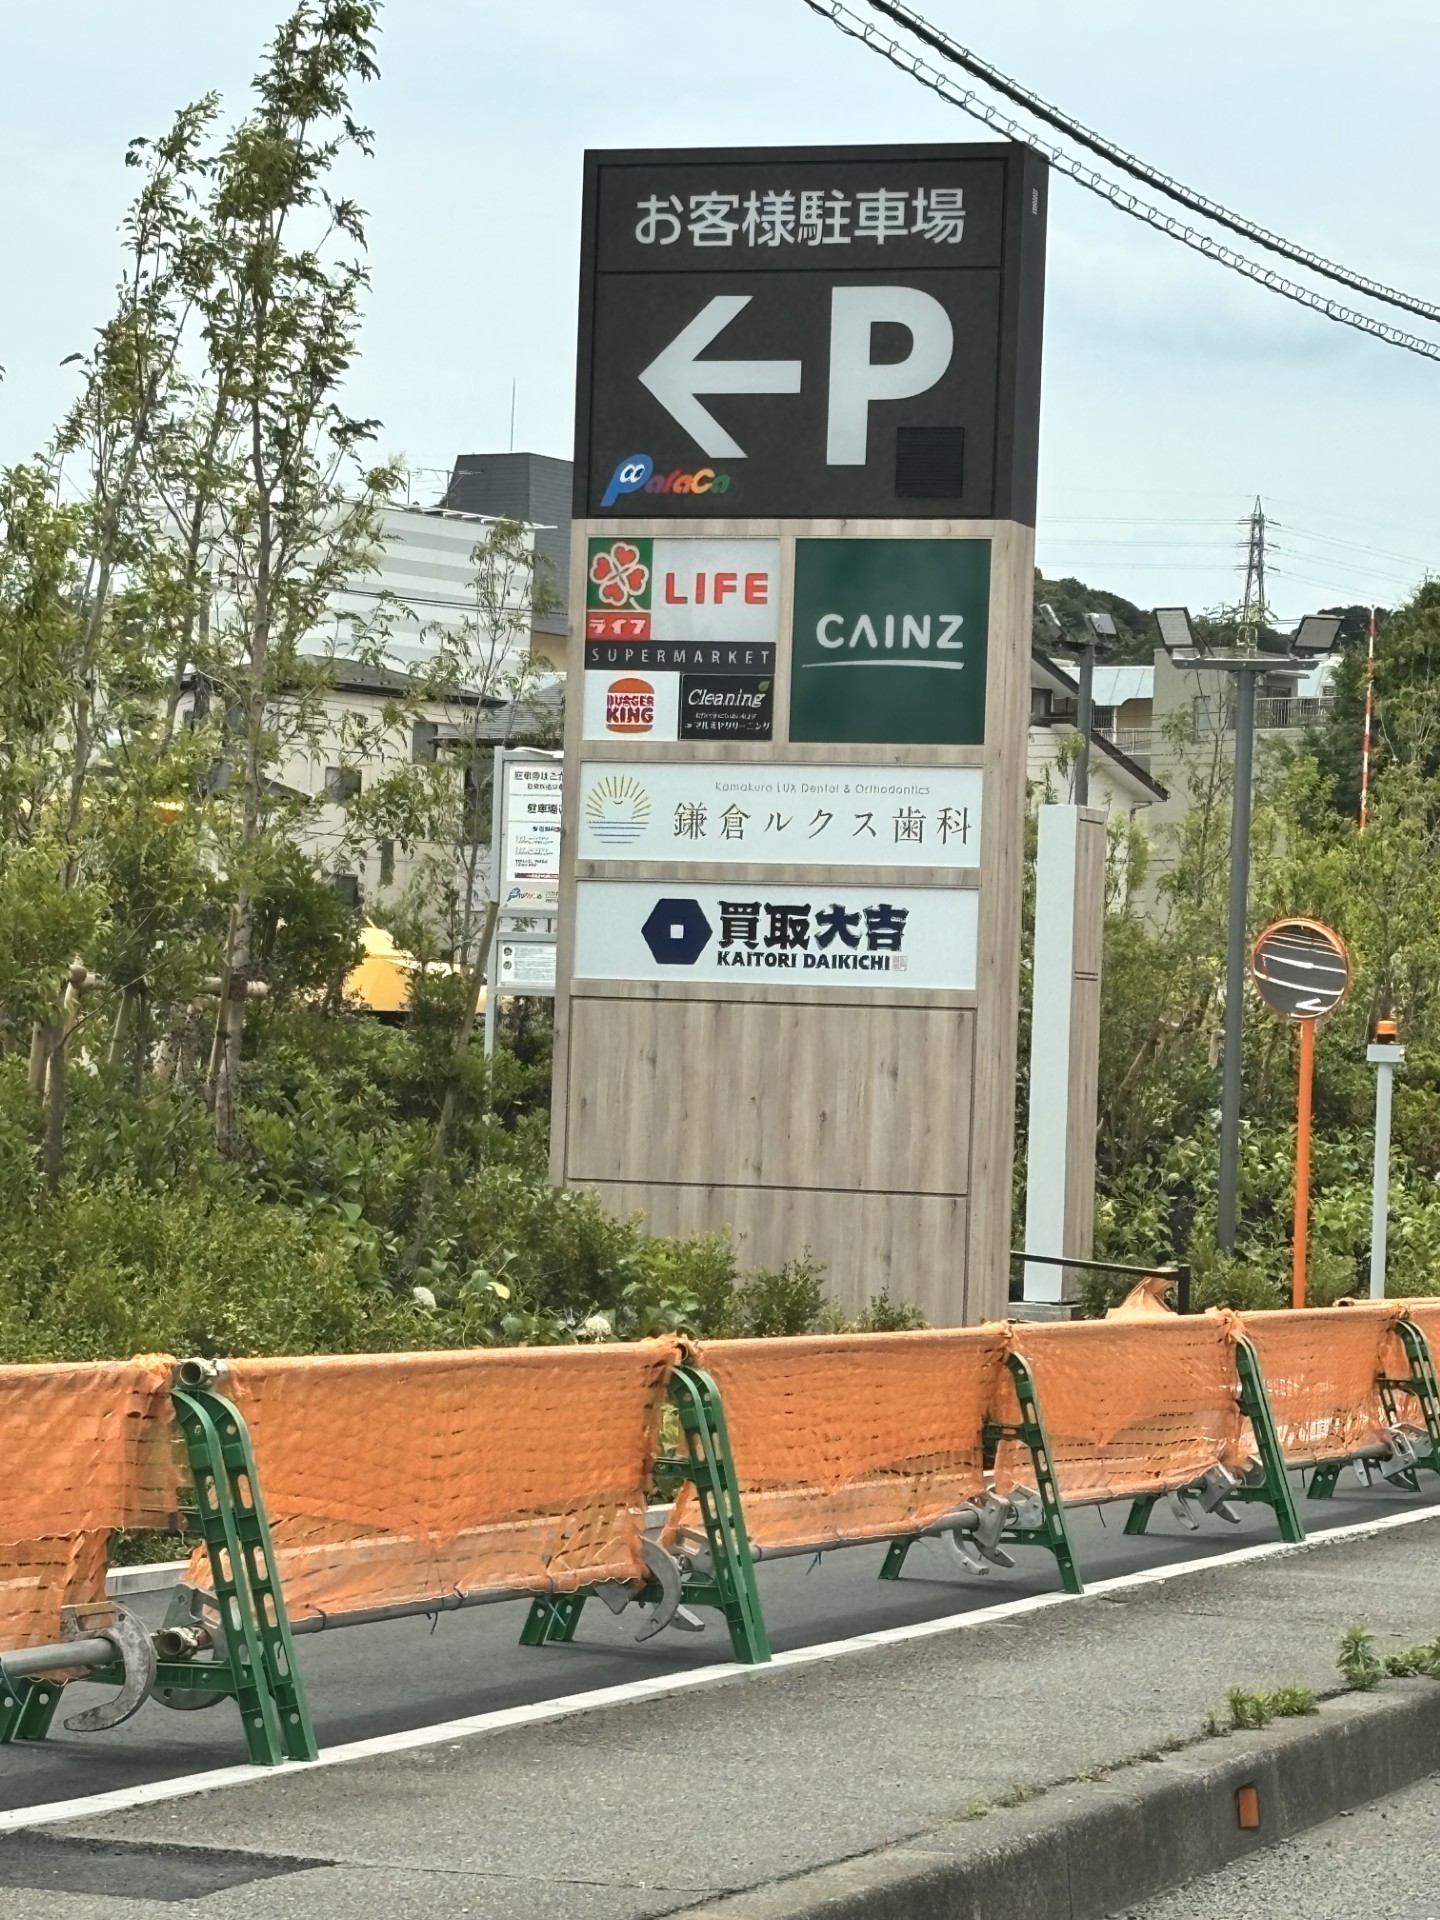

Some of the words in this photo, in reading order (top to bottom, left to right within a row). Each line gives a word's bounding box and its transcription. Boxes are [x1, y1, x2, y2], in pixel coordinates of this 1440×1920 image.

[635, 187, 966, 248] お客様駐車場
[826, 285, 954, 466] P
[665, 572, 768, 605] LIFE
[589, 618, 646, 635] ライフ
[816, 613, 964, 649] CAINZ
[592, 647, 771, 665] SUPERMARKET
[606, 694, 654, 707] BURGER
[688, 688, 766, 708] Cleaning
[606, 707, 654, 723] KING
[715, 781, 773, 793] Kamakura
[801, 782, 839, 794] Dental
[843, 784, 851, 794] &
[855, 783, 930, 796] Orthodontics
[673, 801, 971, 844] 鎌倉ルクス歯科
[716, 900, 910, 952] 買取大吉
[717, 950, 797, 969] KAITORI
[803, 952, 891, 971] DAIKICHI
